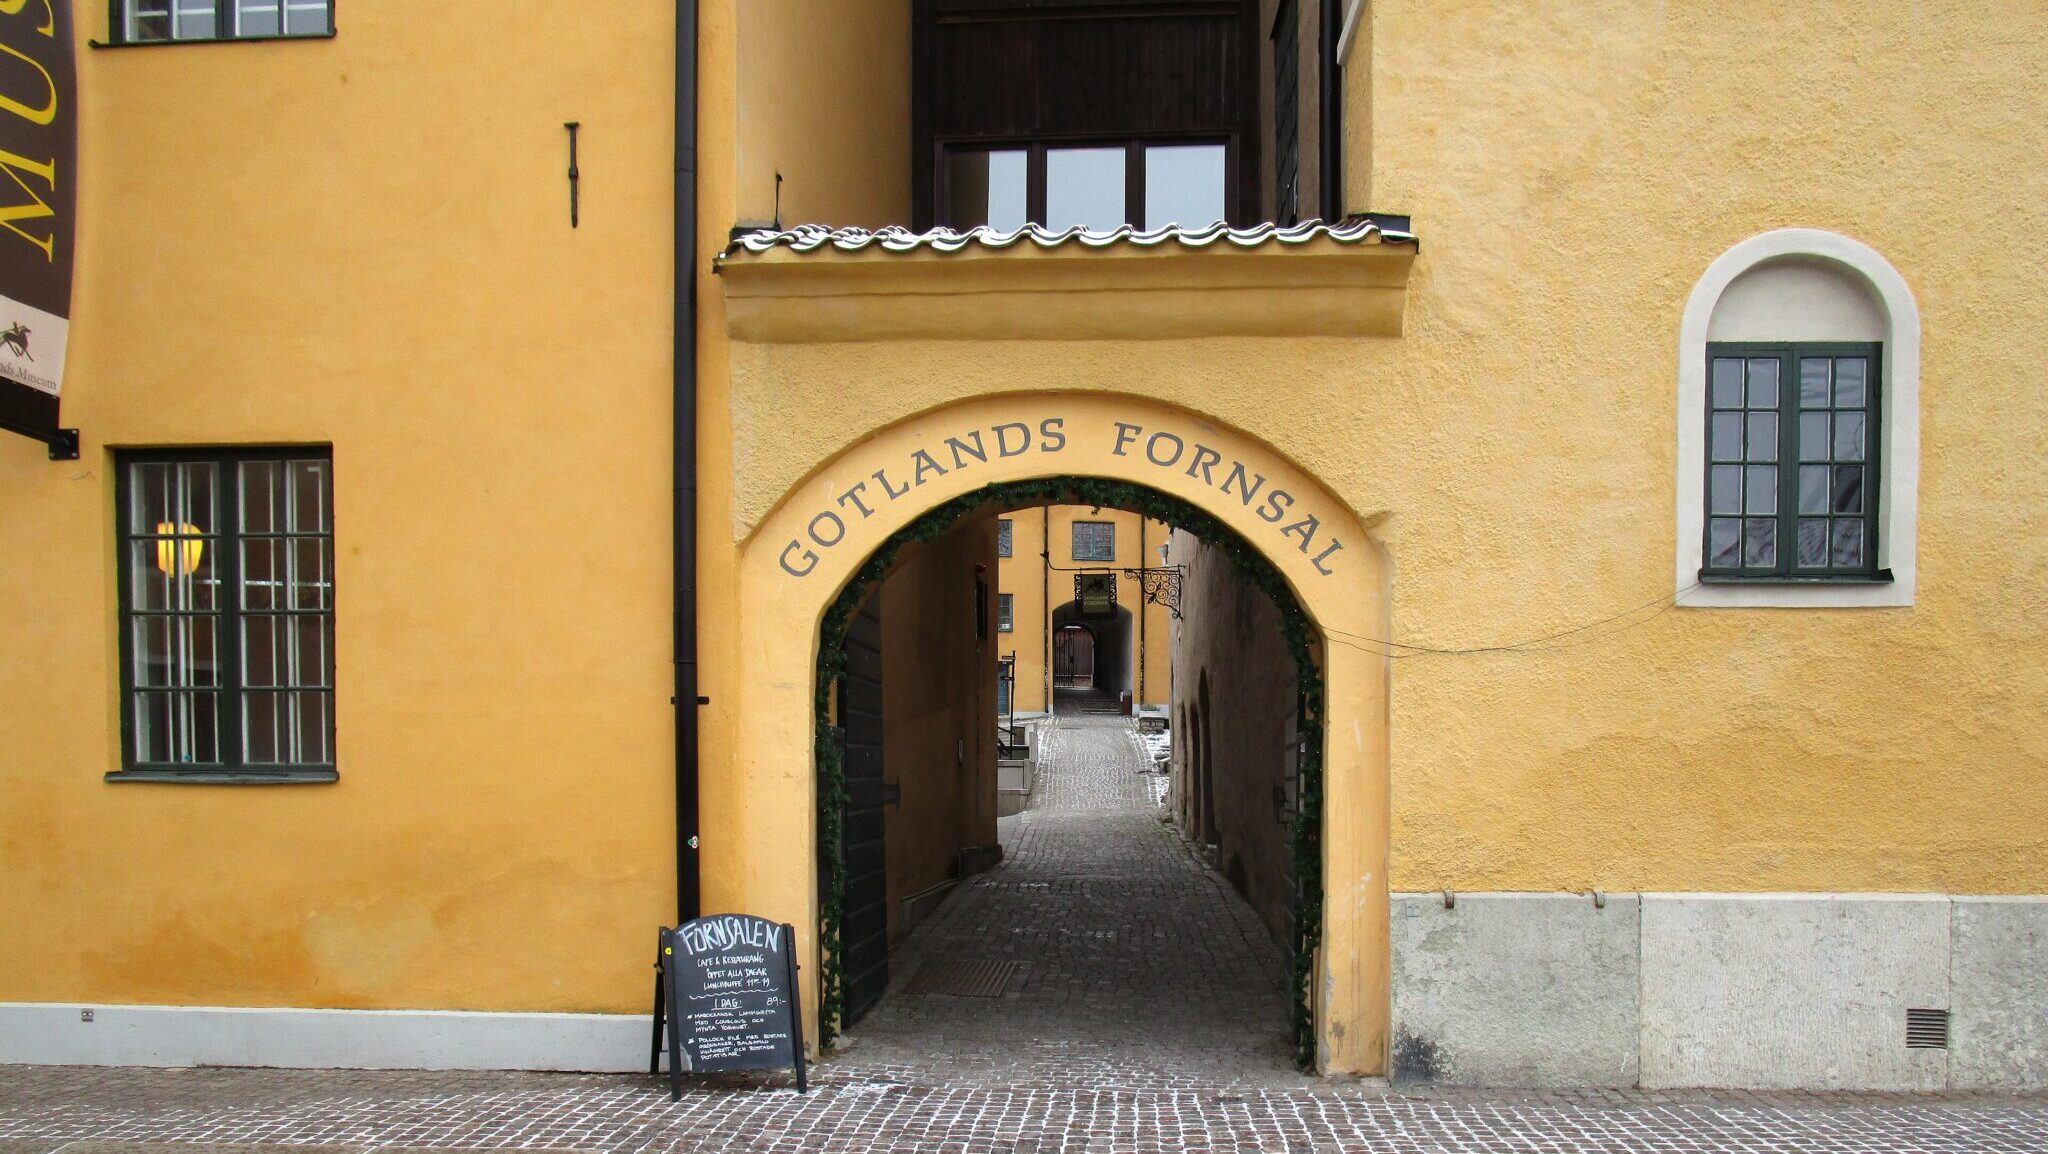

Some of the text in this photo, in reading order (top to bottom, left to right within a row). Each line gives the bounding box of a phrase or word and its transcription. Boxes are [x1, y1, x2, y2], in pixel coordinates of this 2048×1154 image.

[16, 366, 57, 390] Museum
[779, 418, 1344, 578] GOTLANDS FORNSAL
[676, 916, 780, 956] FORNSALEN
[722, 951, 764, 966] RESTAURANG
[727, 969, 743, 979] ALLA
[744, 967, 768, 978] DAGAR
